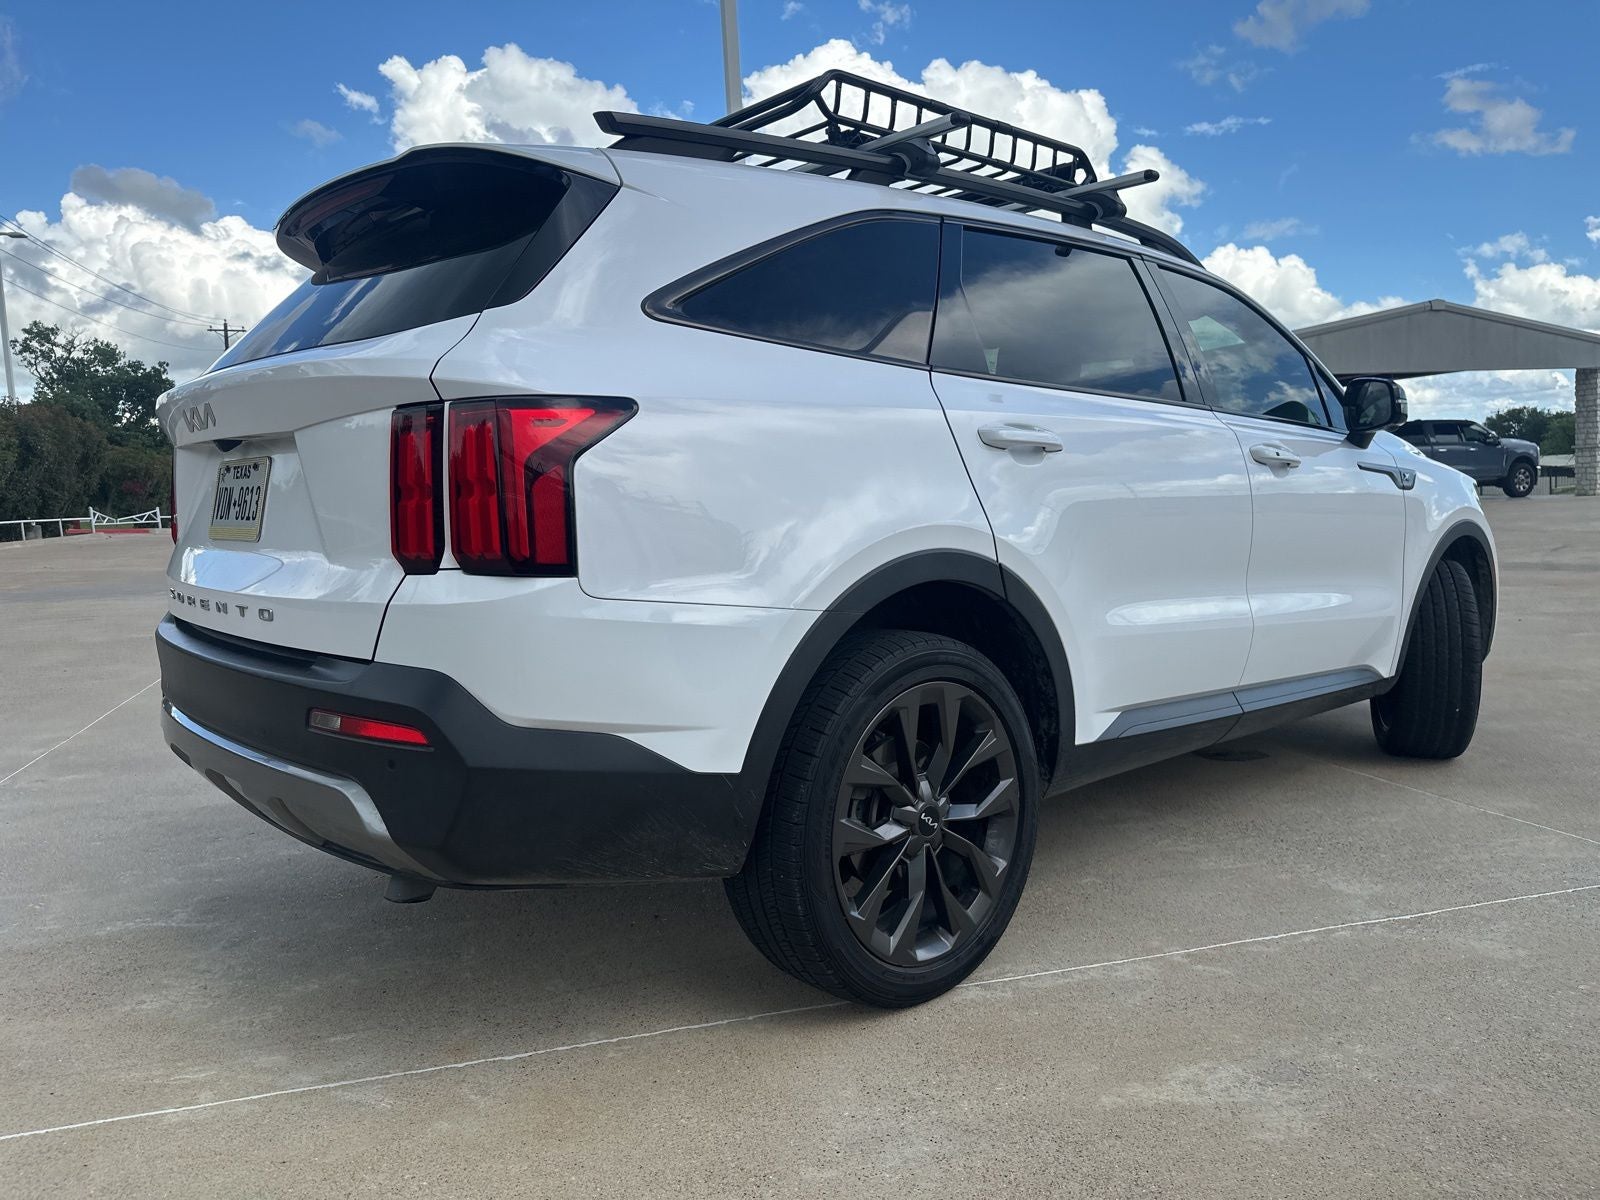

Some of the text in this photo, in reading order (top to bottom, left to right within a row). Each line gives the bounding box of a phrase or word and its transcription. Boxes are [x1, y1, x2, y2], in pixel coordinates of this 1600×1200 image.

[182, 402, 217, 433] KIA
[232, 464, 252, 480] TEXAS
[169, 587, 274, 622] SORENTO
